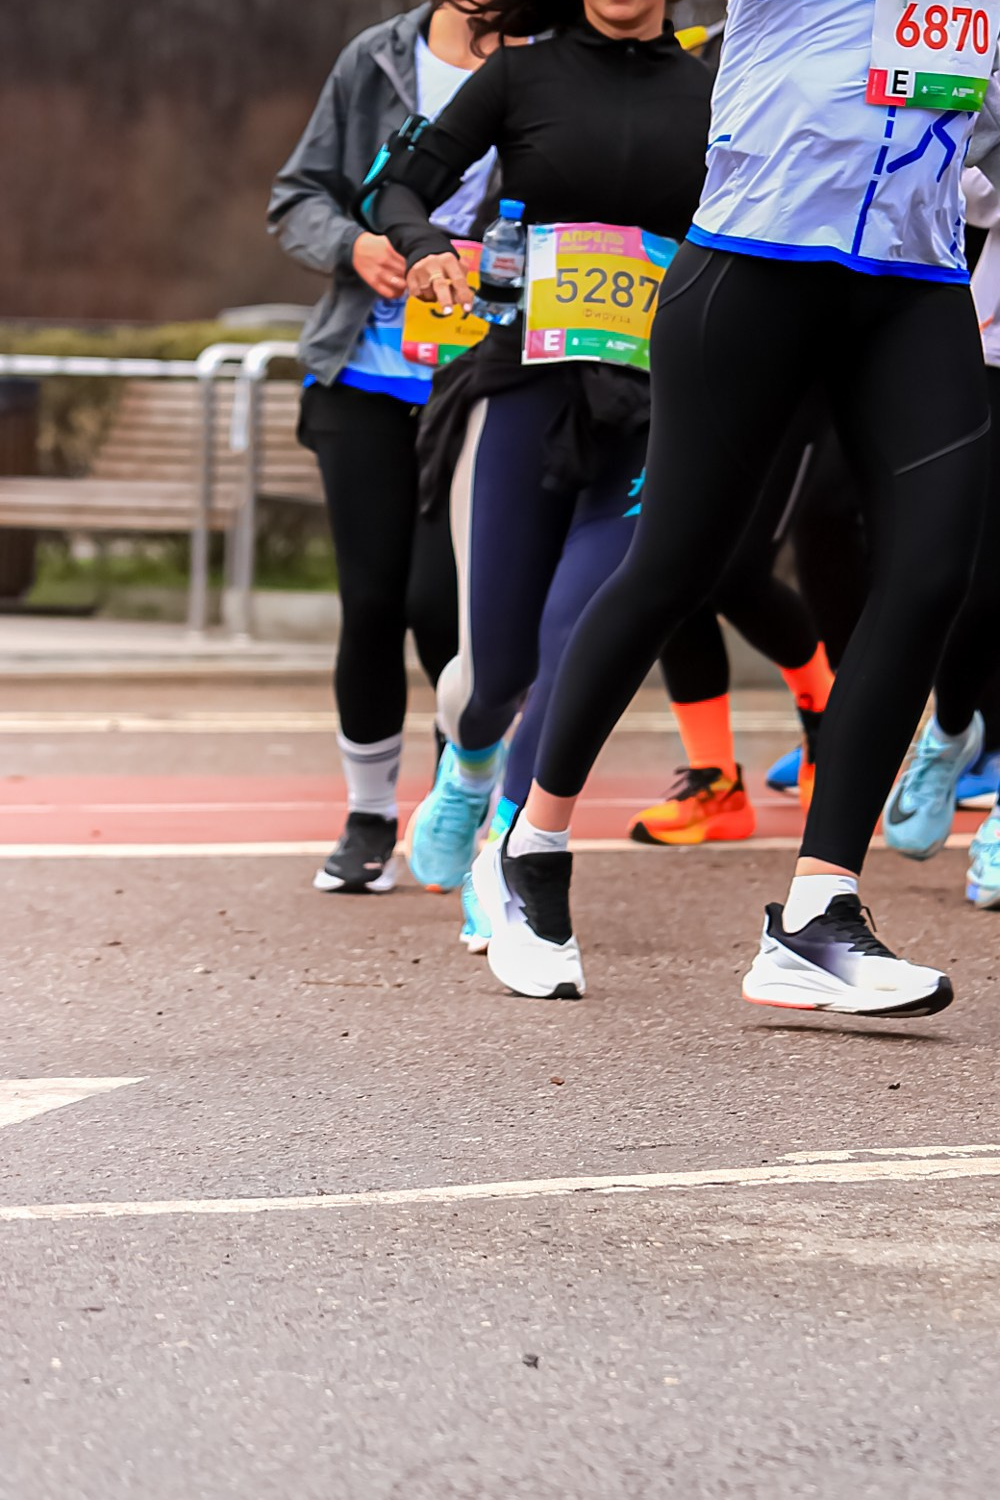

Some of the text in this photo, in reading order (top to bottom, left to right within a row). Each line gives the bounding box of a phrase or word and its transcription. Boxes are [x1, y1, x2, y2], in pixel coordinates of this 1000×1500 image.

[895, 2, 990, 55] 6870
[892, 69, 910, 96] E
[555, 267, 660, 314] 5287
[543, 330, 562, 351] E
